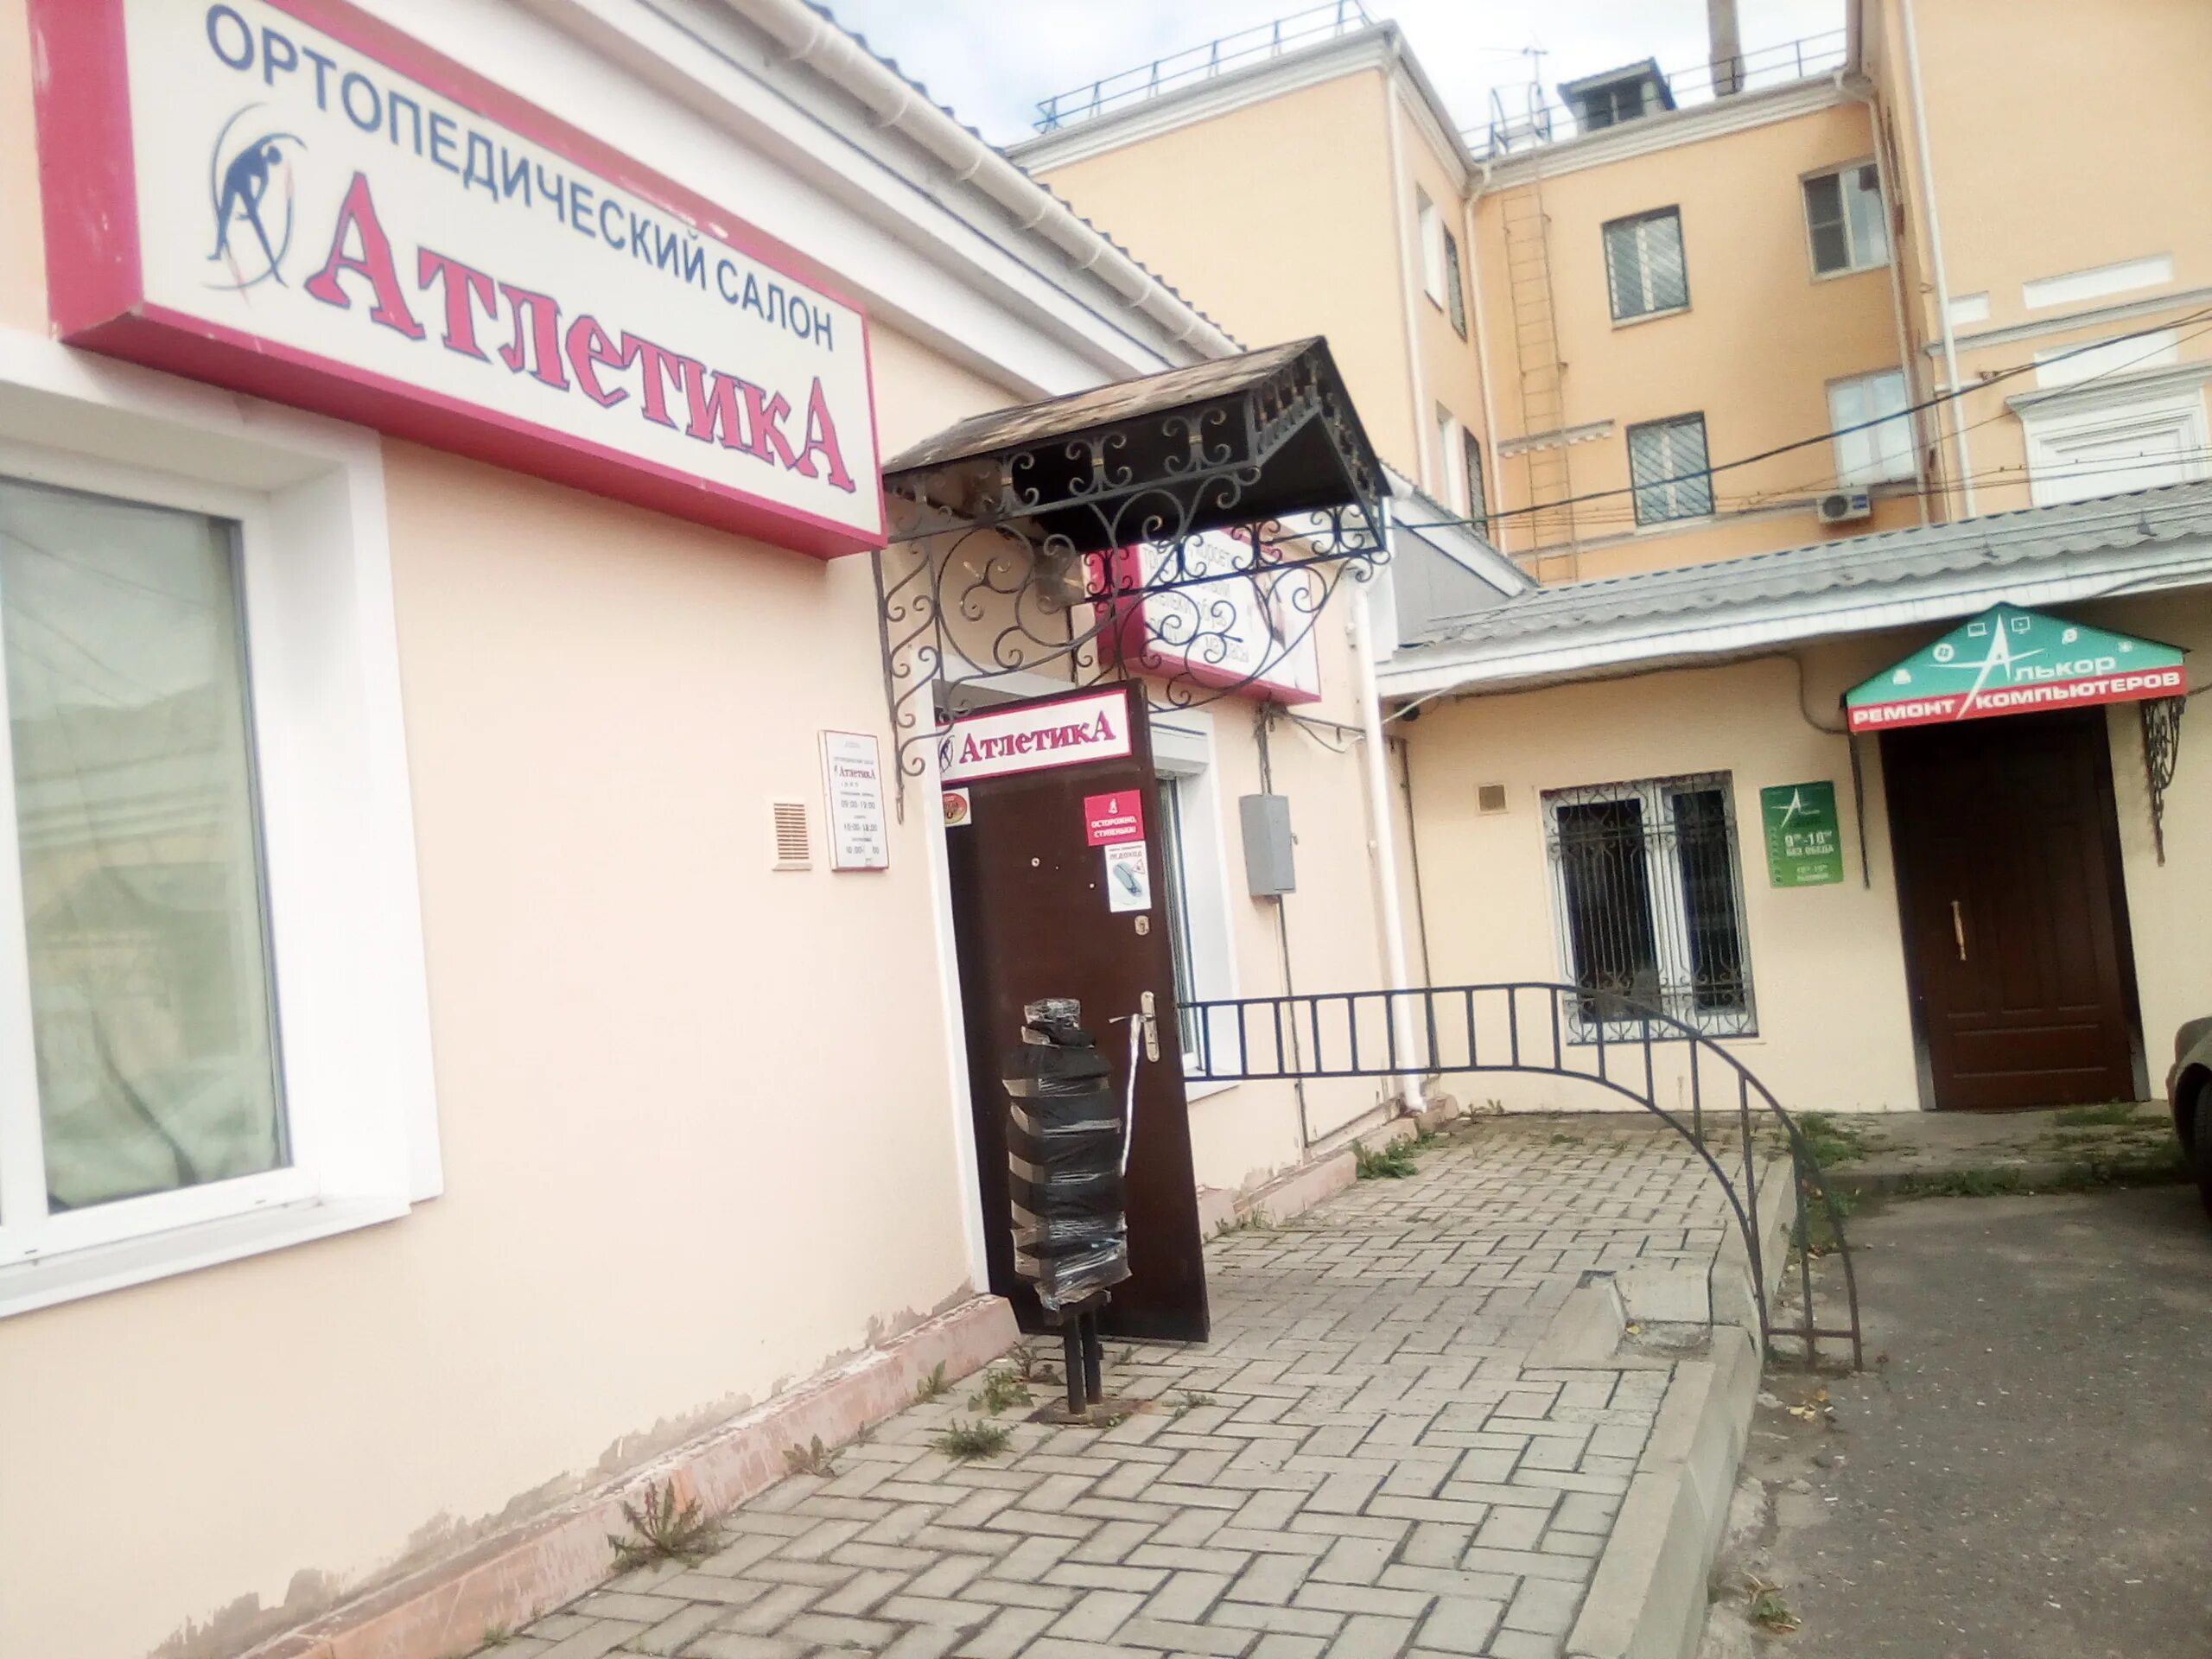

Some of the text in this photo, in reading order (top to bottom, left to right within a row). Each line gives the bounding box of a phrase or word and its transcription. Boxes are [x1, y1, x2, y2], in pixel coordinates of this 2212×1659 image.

[205, 3, 835, 352] ОРТОПЕДИЧЕСКИЙ САЛОН
[1852, 671, 2181, 725] РЕМОНТ КОМПЬЮТЕРОВ
